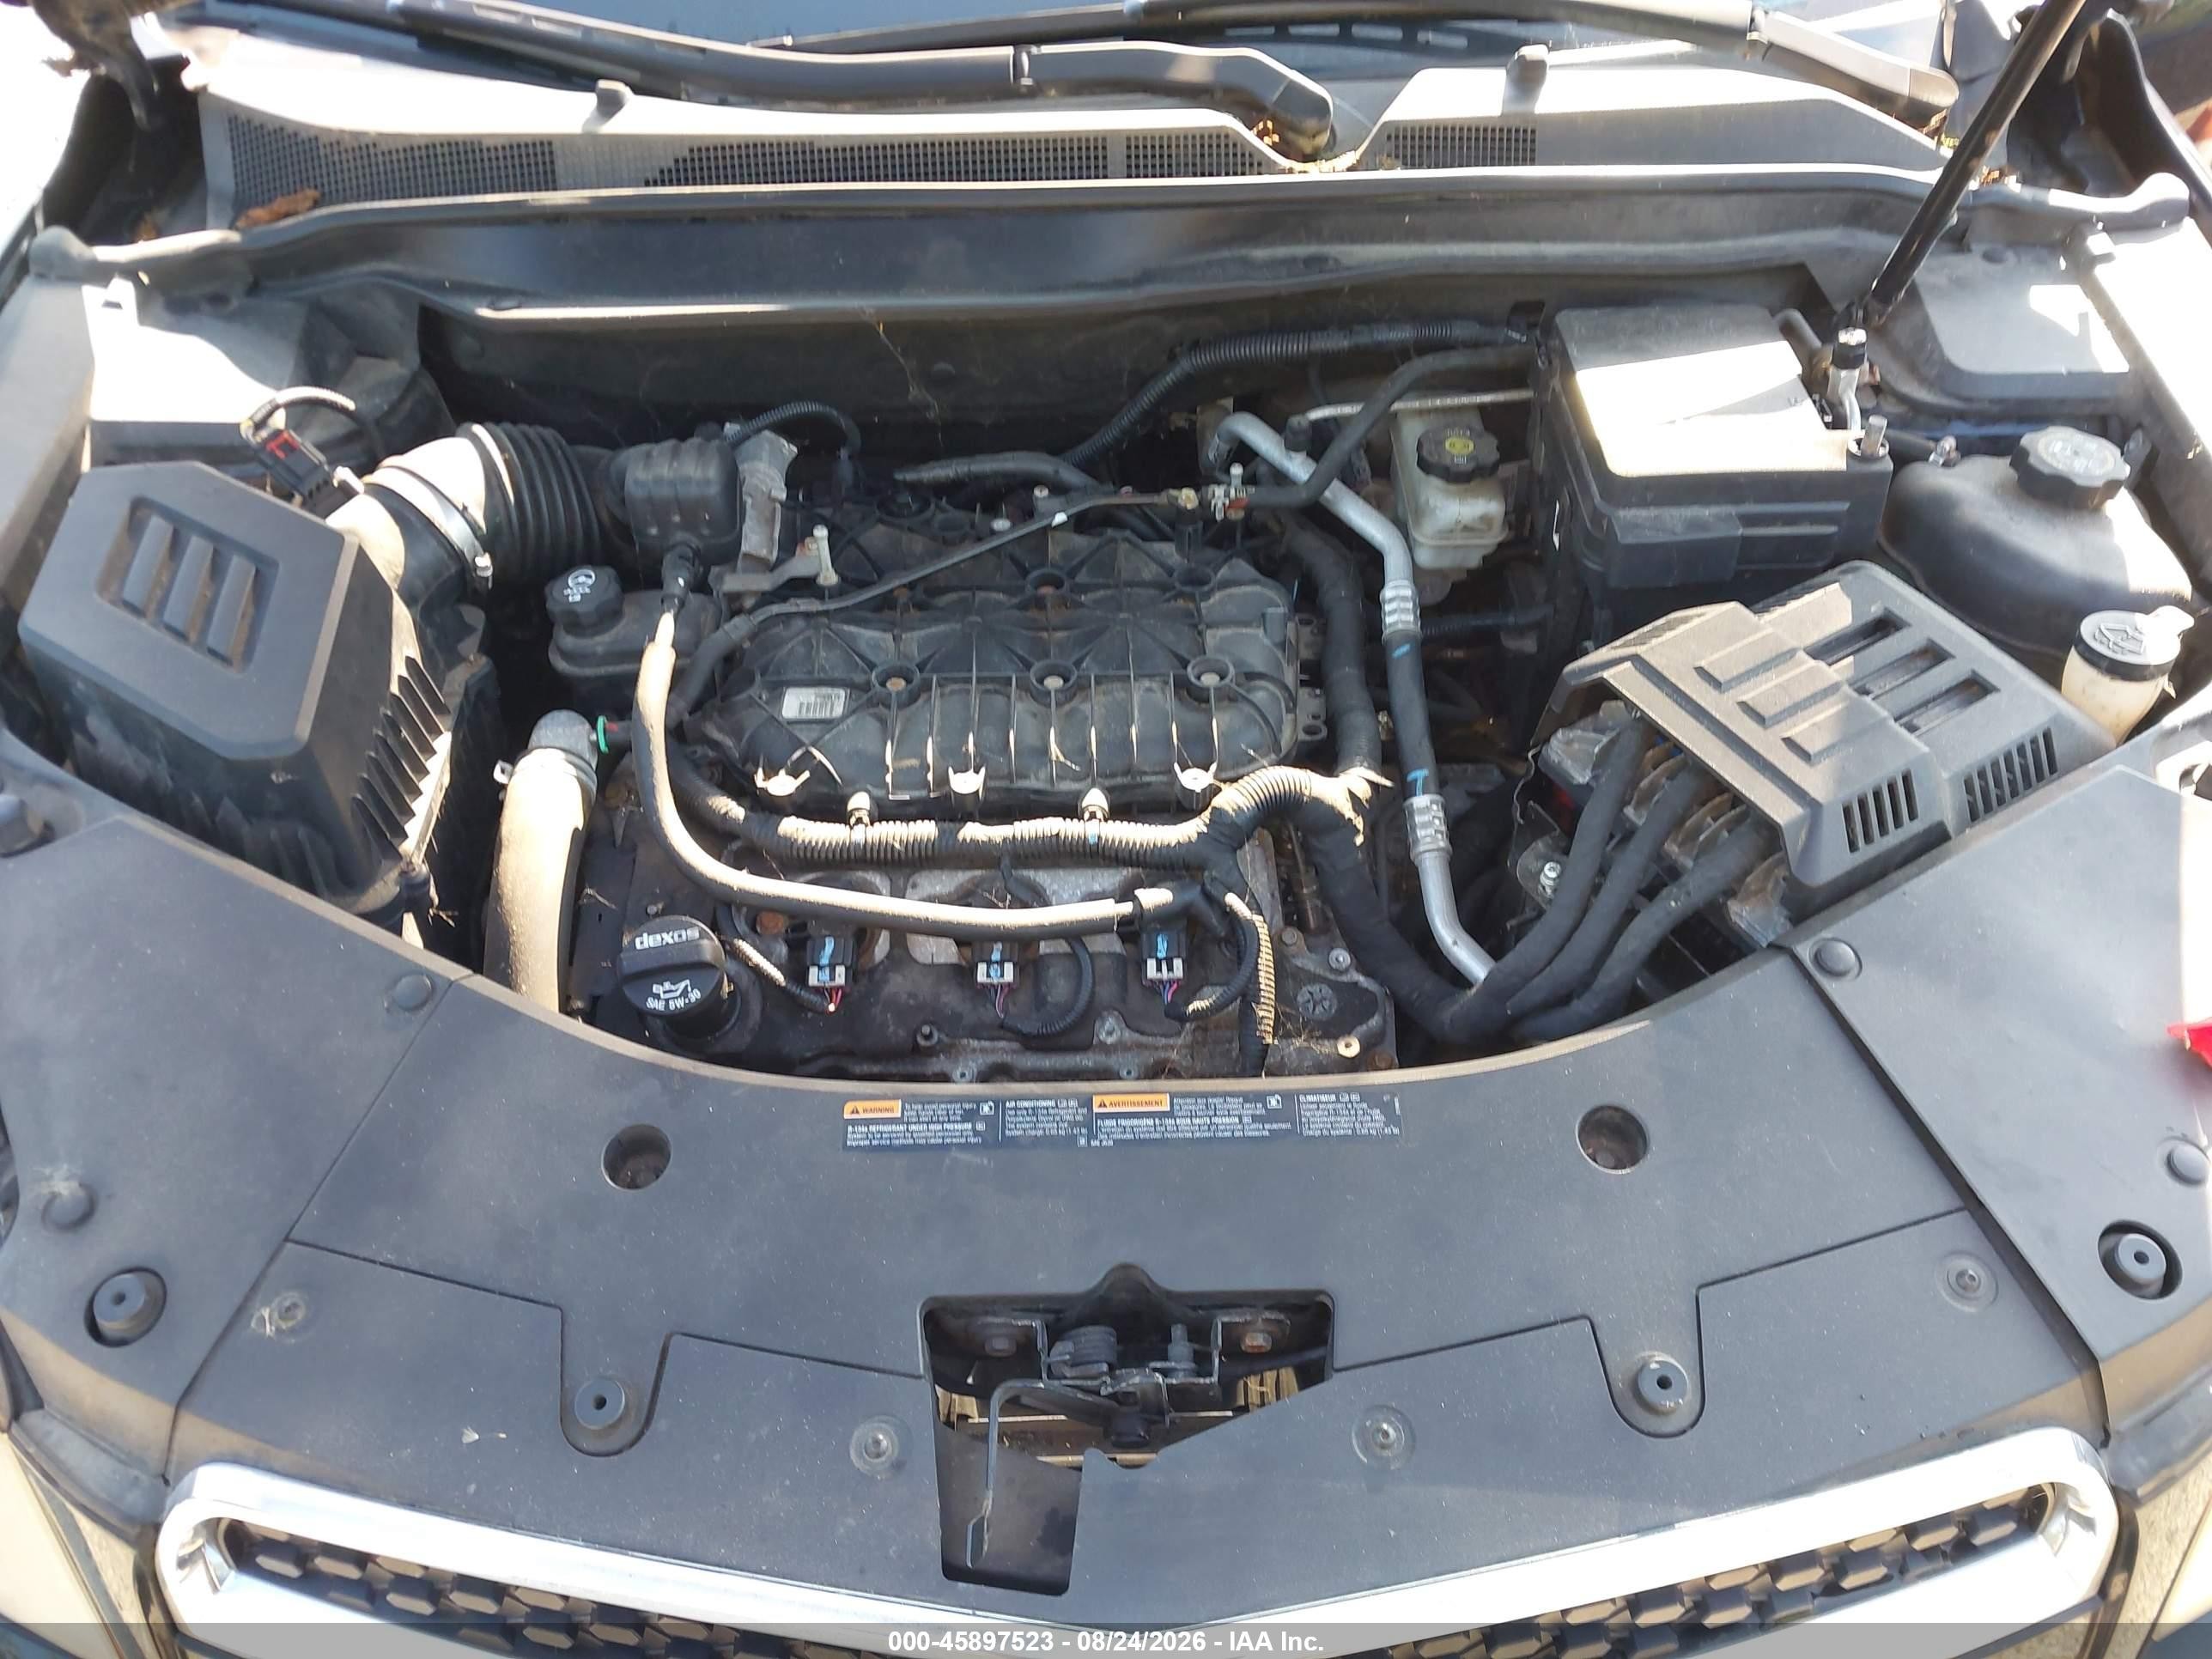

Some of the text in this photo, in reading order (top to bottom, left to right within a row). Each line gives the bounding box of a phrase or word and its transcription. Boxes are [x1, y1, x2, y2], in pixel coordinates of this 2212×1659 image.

[635, 926, 700, 951] dexos
[646, 996, 665, 1011] SAE
[862, 1105, 895, 1114] WARNING
[1109, 1099, 1164, 1108] AVERTISSEMENT
